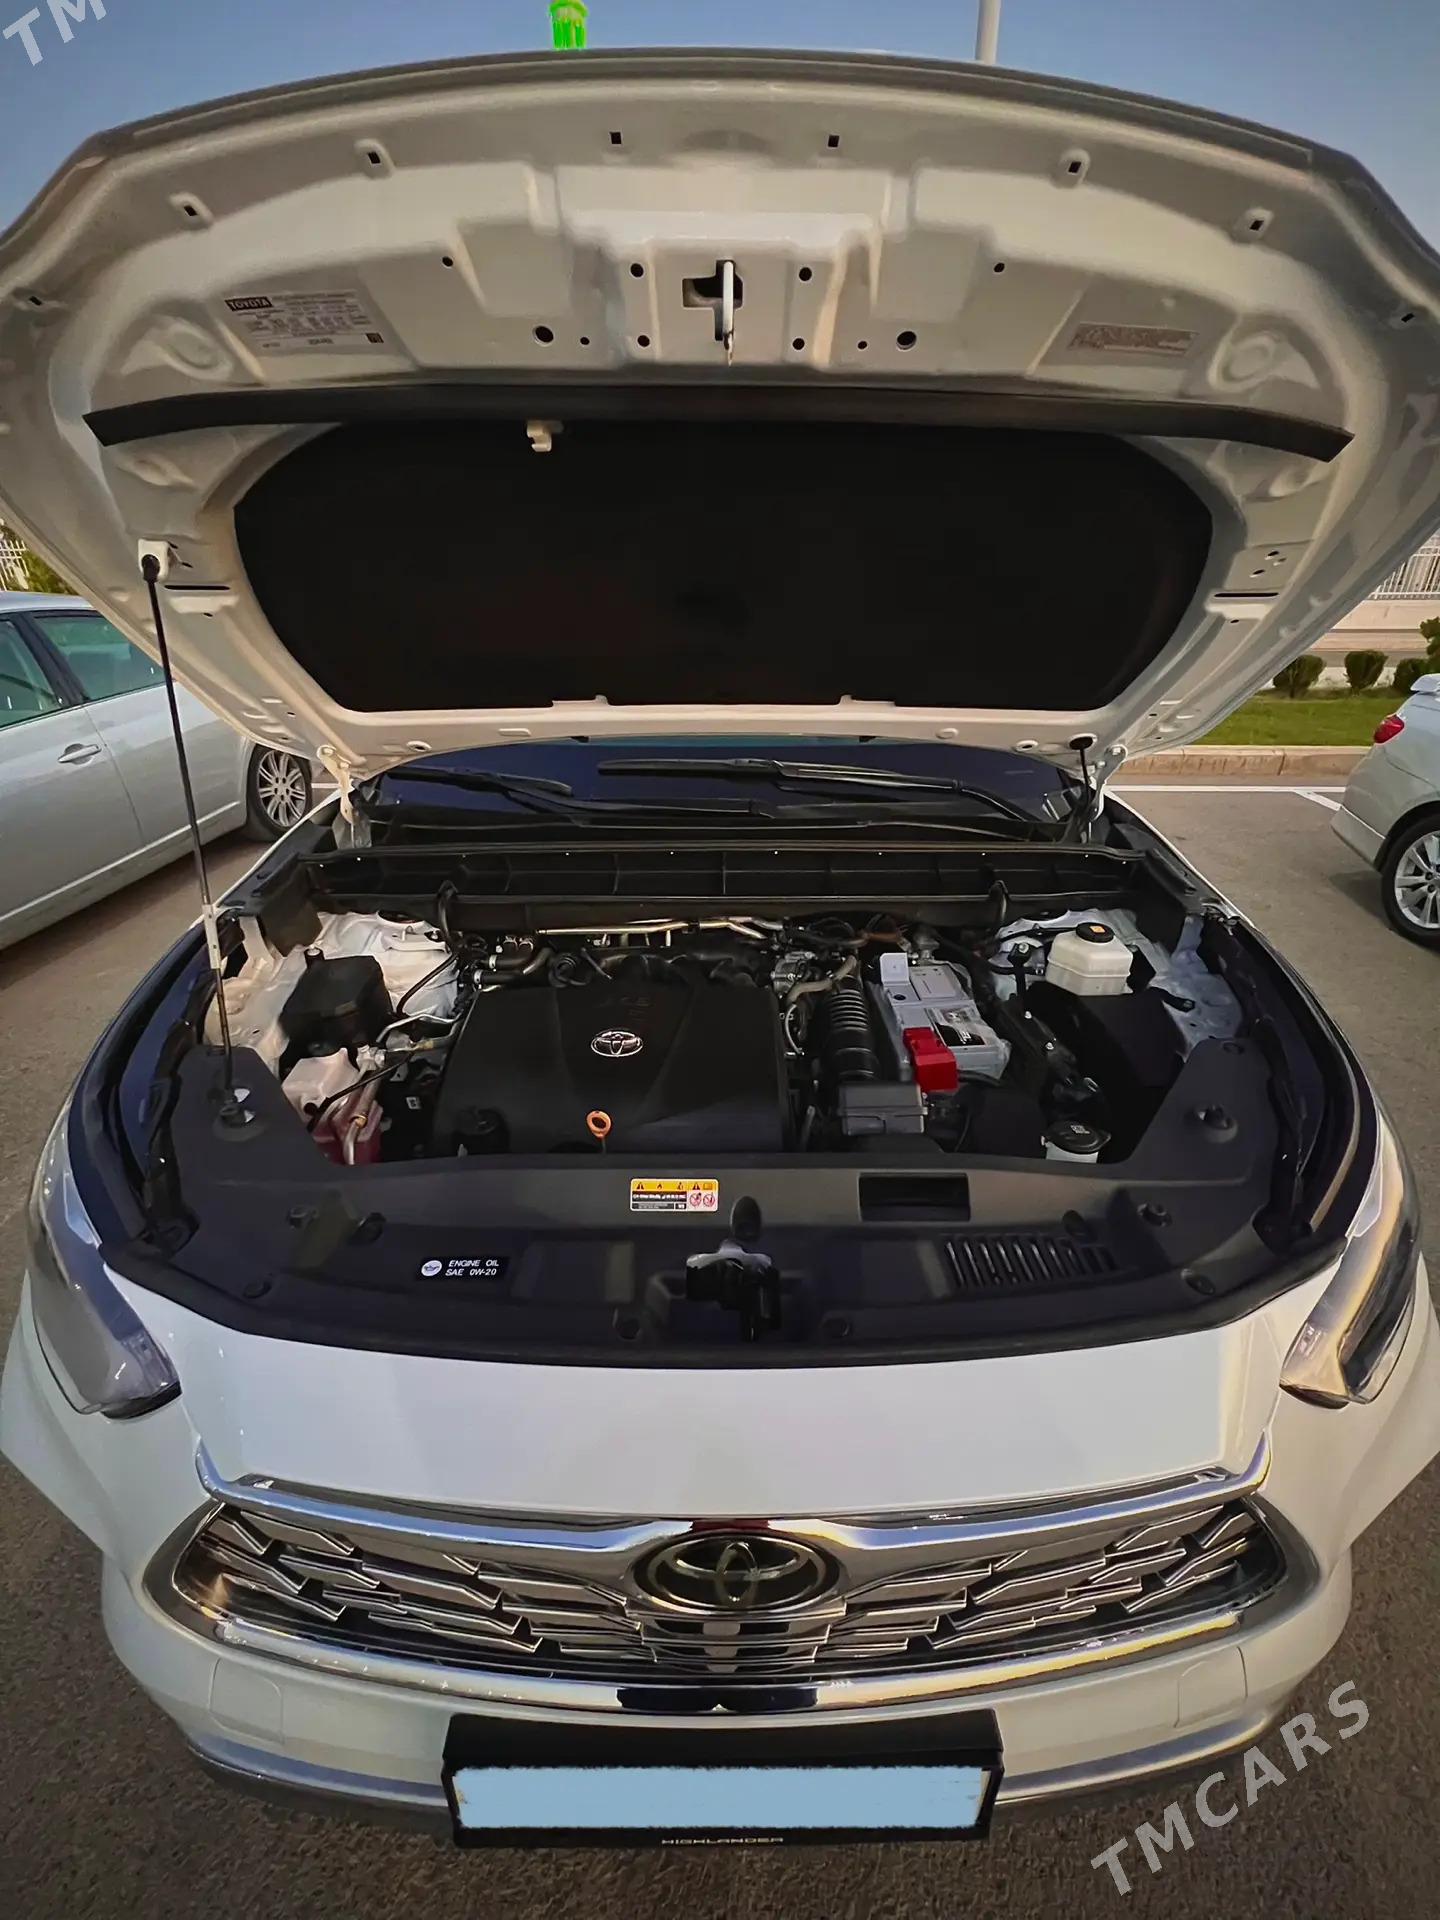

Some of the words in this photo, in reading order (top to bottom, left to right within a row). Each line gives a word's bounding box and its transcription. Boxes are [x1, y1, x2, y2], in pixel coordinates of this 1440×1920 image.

[226, 298, 271, 310] TOYOTA
[448, 1259, 481, 1267] ENGINE
[485, 1259, 500, 1267] OIL
[445, 1268, 464, 1276] SAE
[469, 1268, 497, 1276] 0W-20
